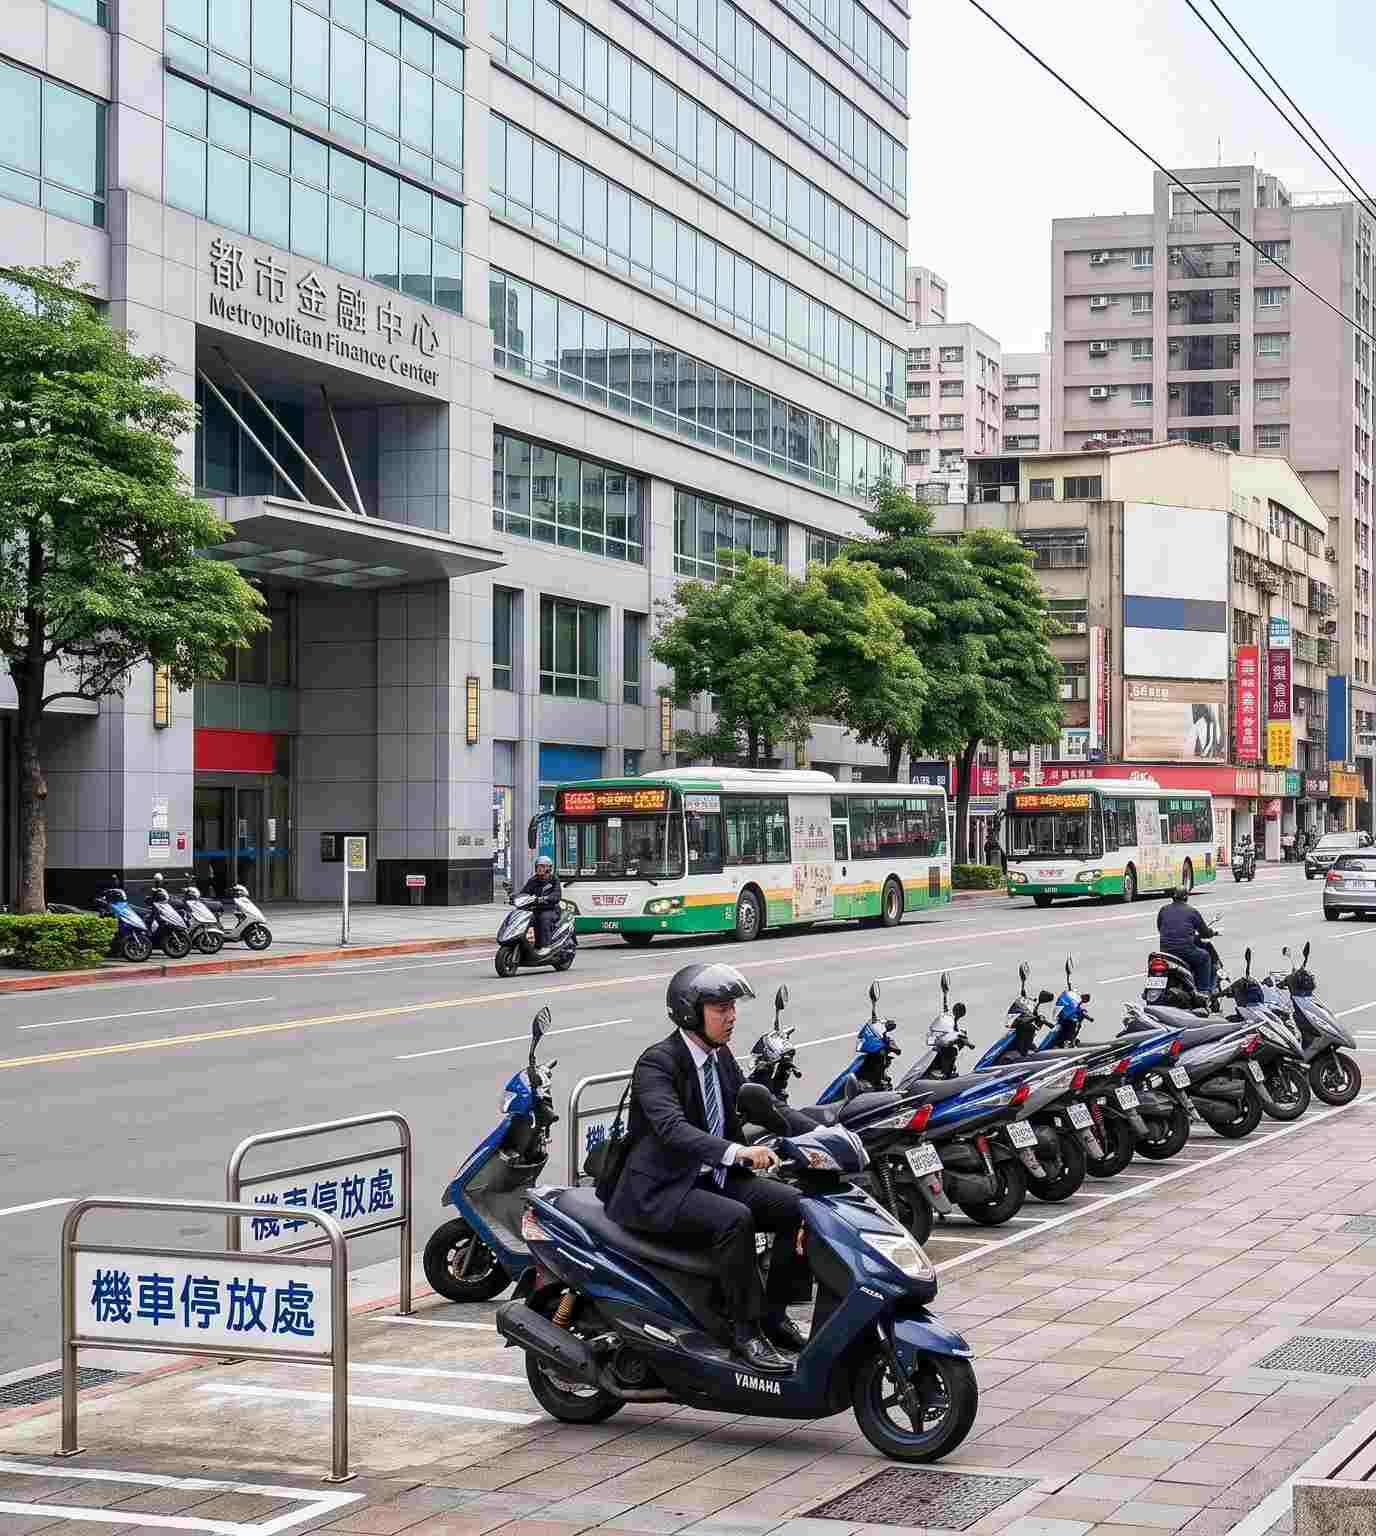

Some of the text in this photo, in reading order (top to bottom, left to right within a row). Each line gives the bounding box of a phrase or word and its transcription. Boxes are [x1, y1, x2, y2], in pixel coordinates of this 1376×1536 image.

[209, 238, 440, 358] 都市金融中心
[209, 292, 440, 387] Metropolitan Finance Center
[91, 1268, 315, 1337] 機車停放處
[735, 1372, 782, 1395] YAMAHA
